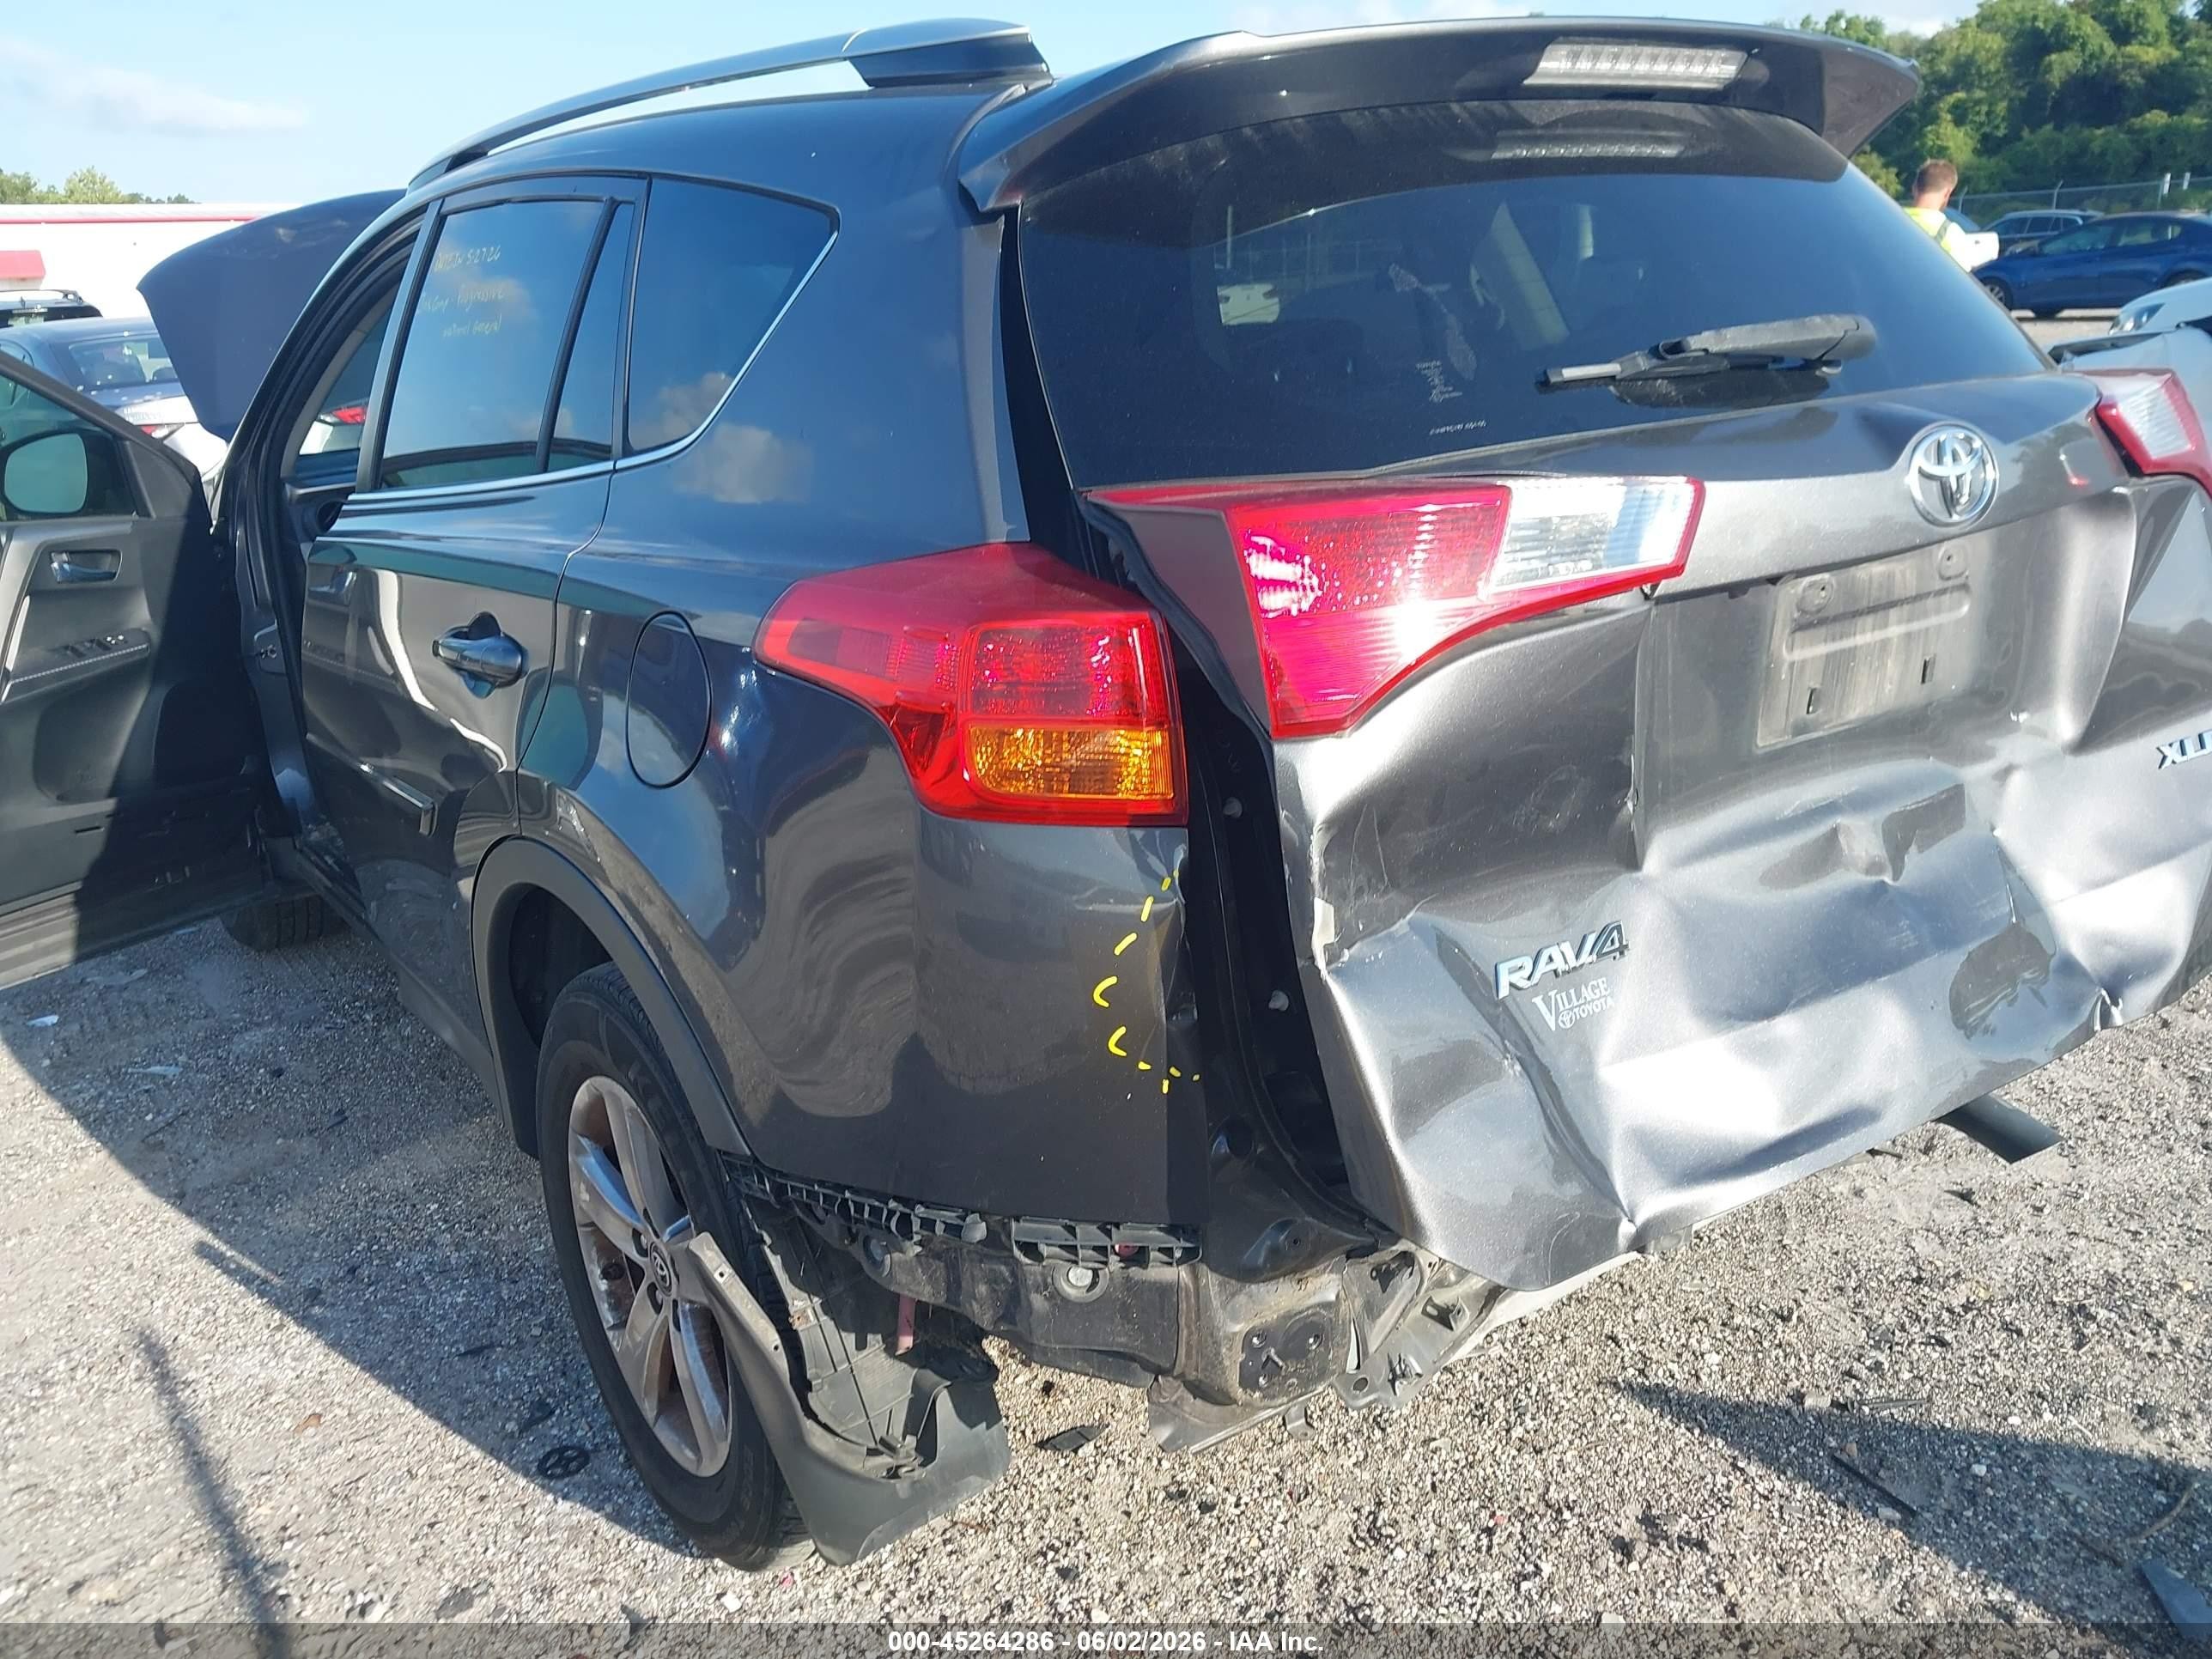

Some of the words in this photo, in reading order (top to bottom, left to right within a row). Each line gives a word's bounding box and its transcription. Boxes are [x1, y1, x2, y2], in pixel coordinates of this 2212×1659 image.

[1494, 920, 1630, 1000] RAV4
[1532, 976, 1610, 1031] VILLAGE
[1573, 999, 1615, 1020] TOYOTA
